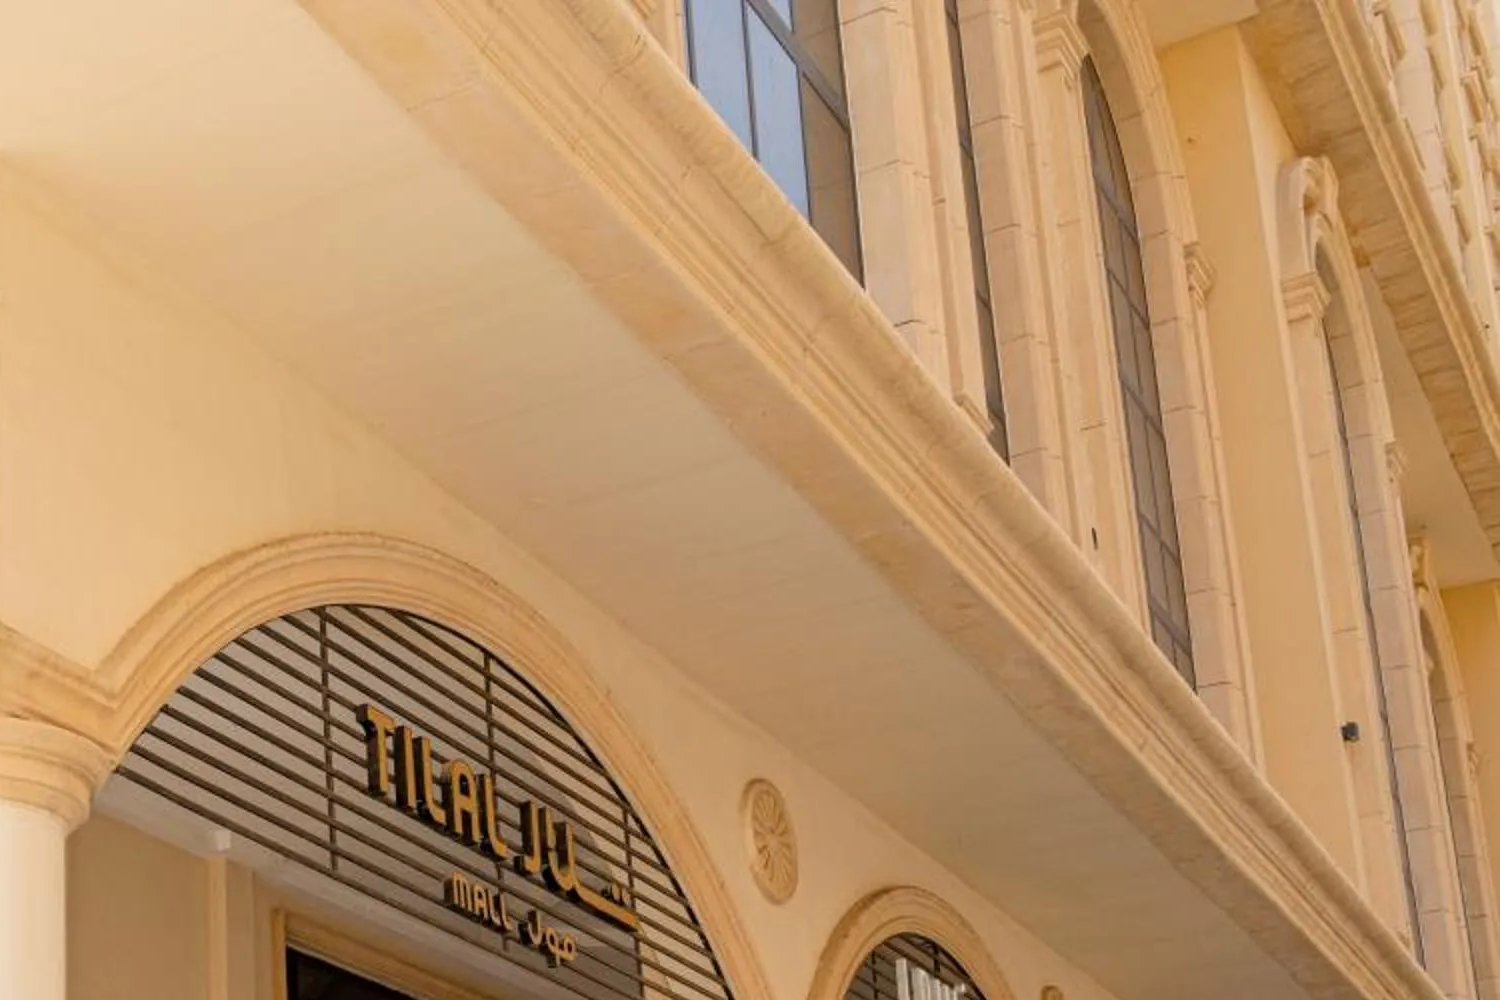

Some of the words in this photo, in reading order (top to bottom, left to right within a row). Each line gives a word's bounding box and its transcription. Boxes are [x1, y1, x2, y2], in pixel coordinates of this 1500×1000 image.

[356, 703, 509, 860] TILAL
[444, 872, 513, 933] MALL
[519, 909, 577, 968] مول
